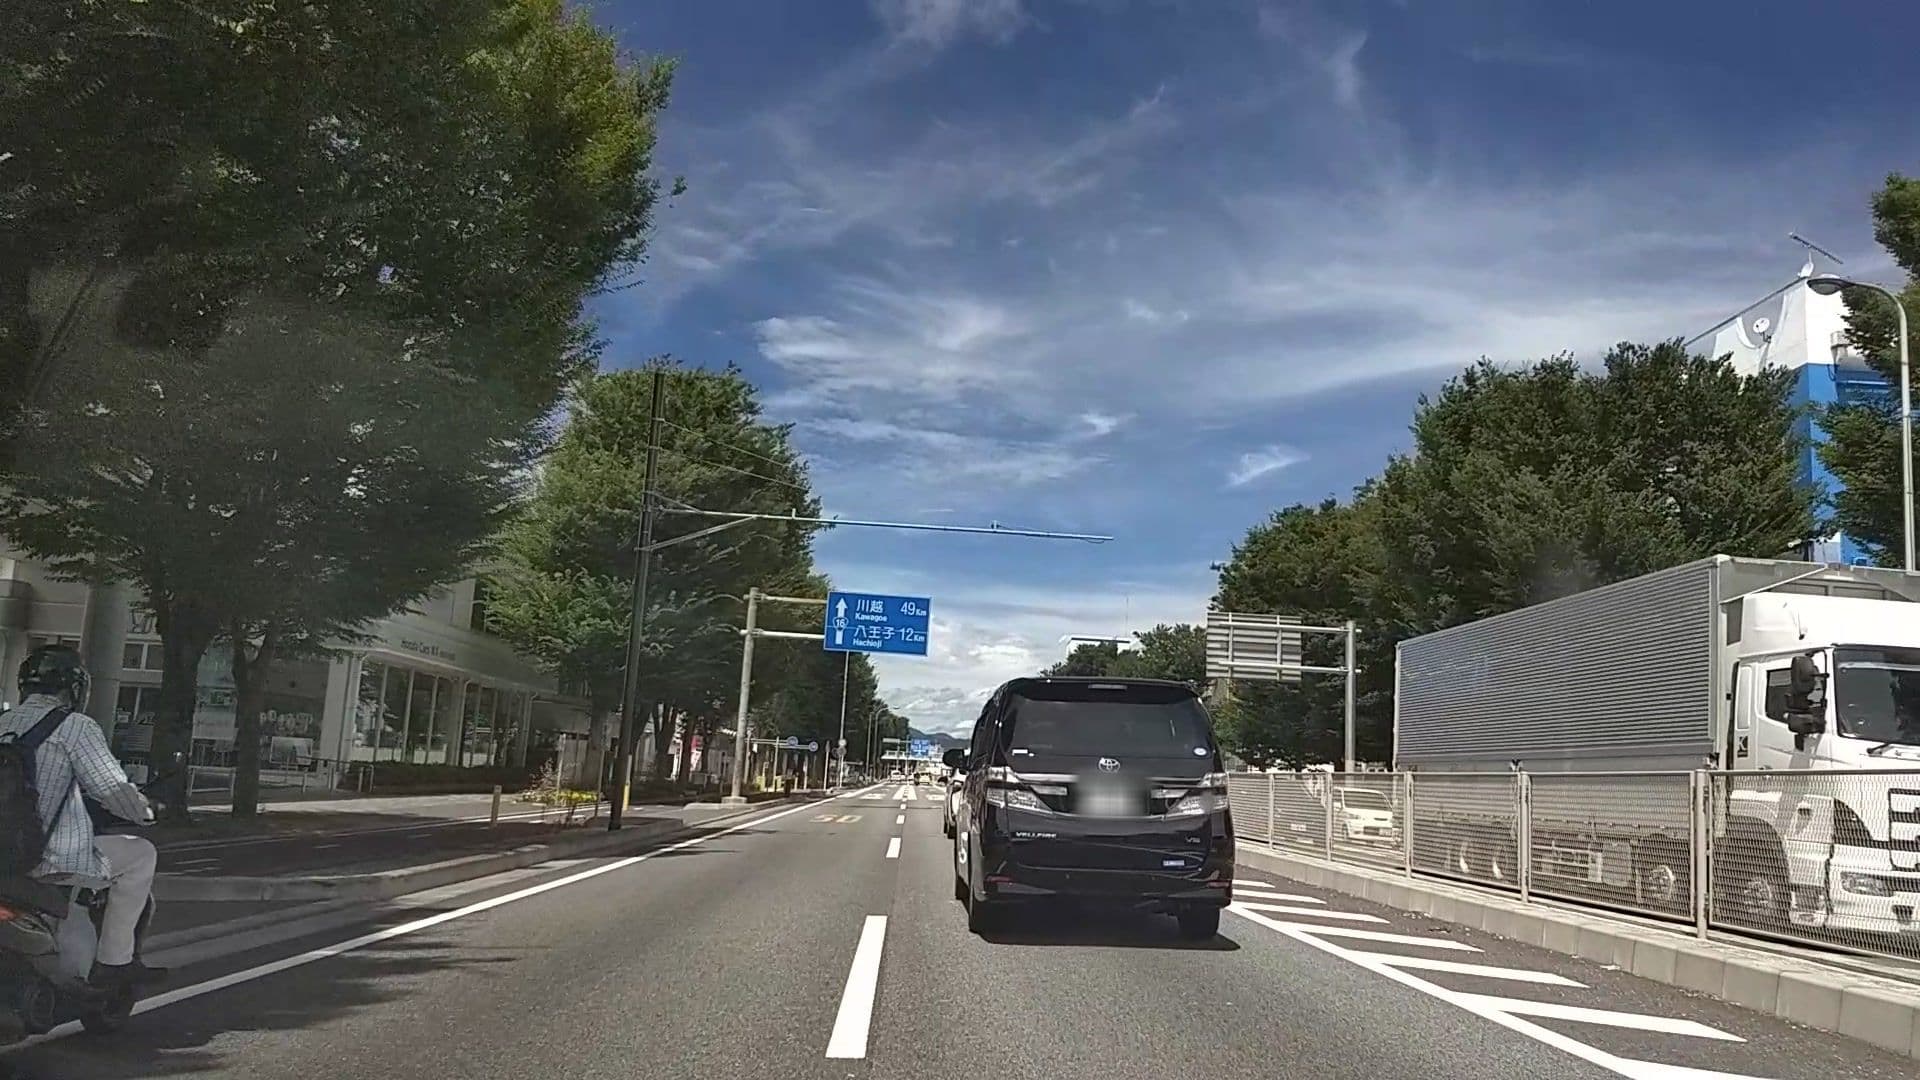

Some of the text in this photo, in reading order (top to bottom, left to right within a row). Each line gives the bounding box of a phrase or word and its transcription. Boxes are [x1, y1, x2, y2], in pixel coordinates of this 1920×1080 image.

[856, 600, 884, 613] 川越
[855, 613, 887, 622] Kawagoe
[836, 619, 845, 628] 16
[853, 625, 895, 639] 八王子
[853, 638, 882, 648] Hachioji
